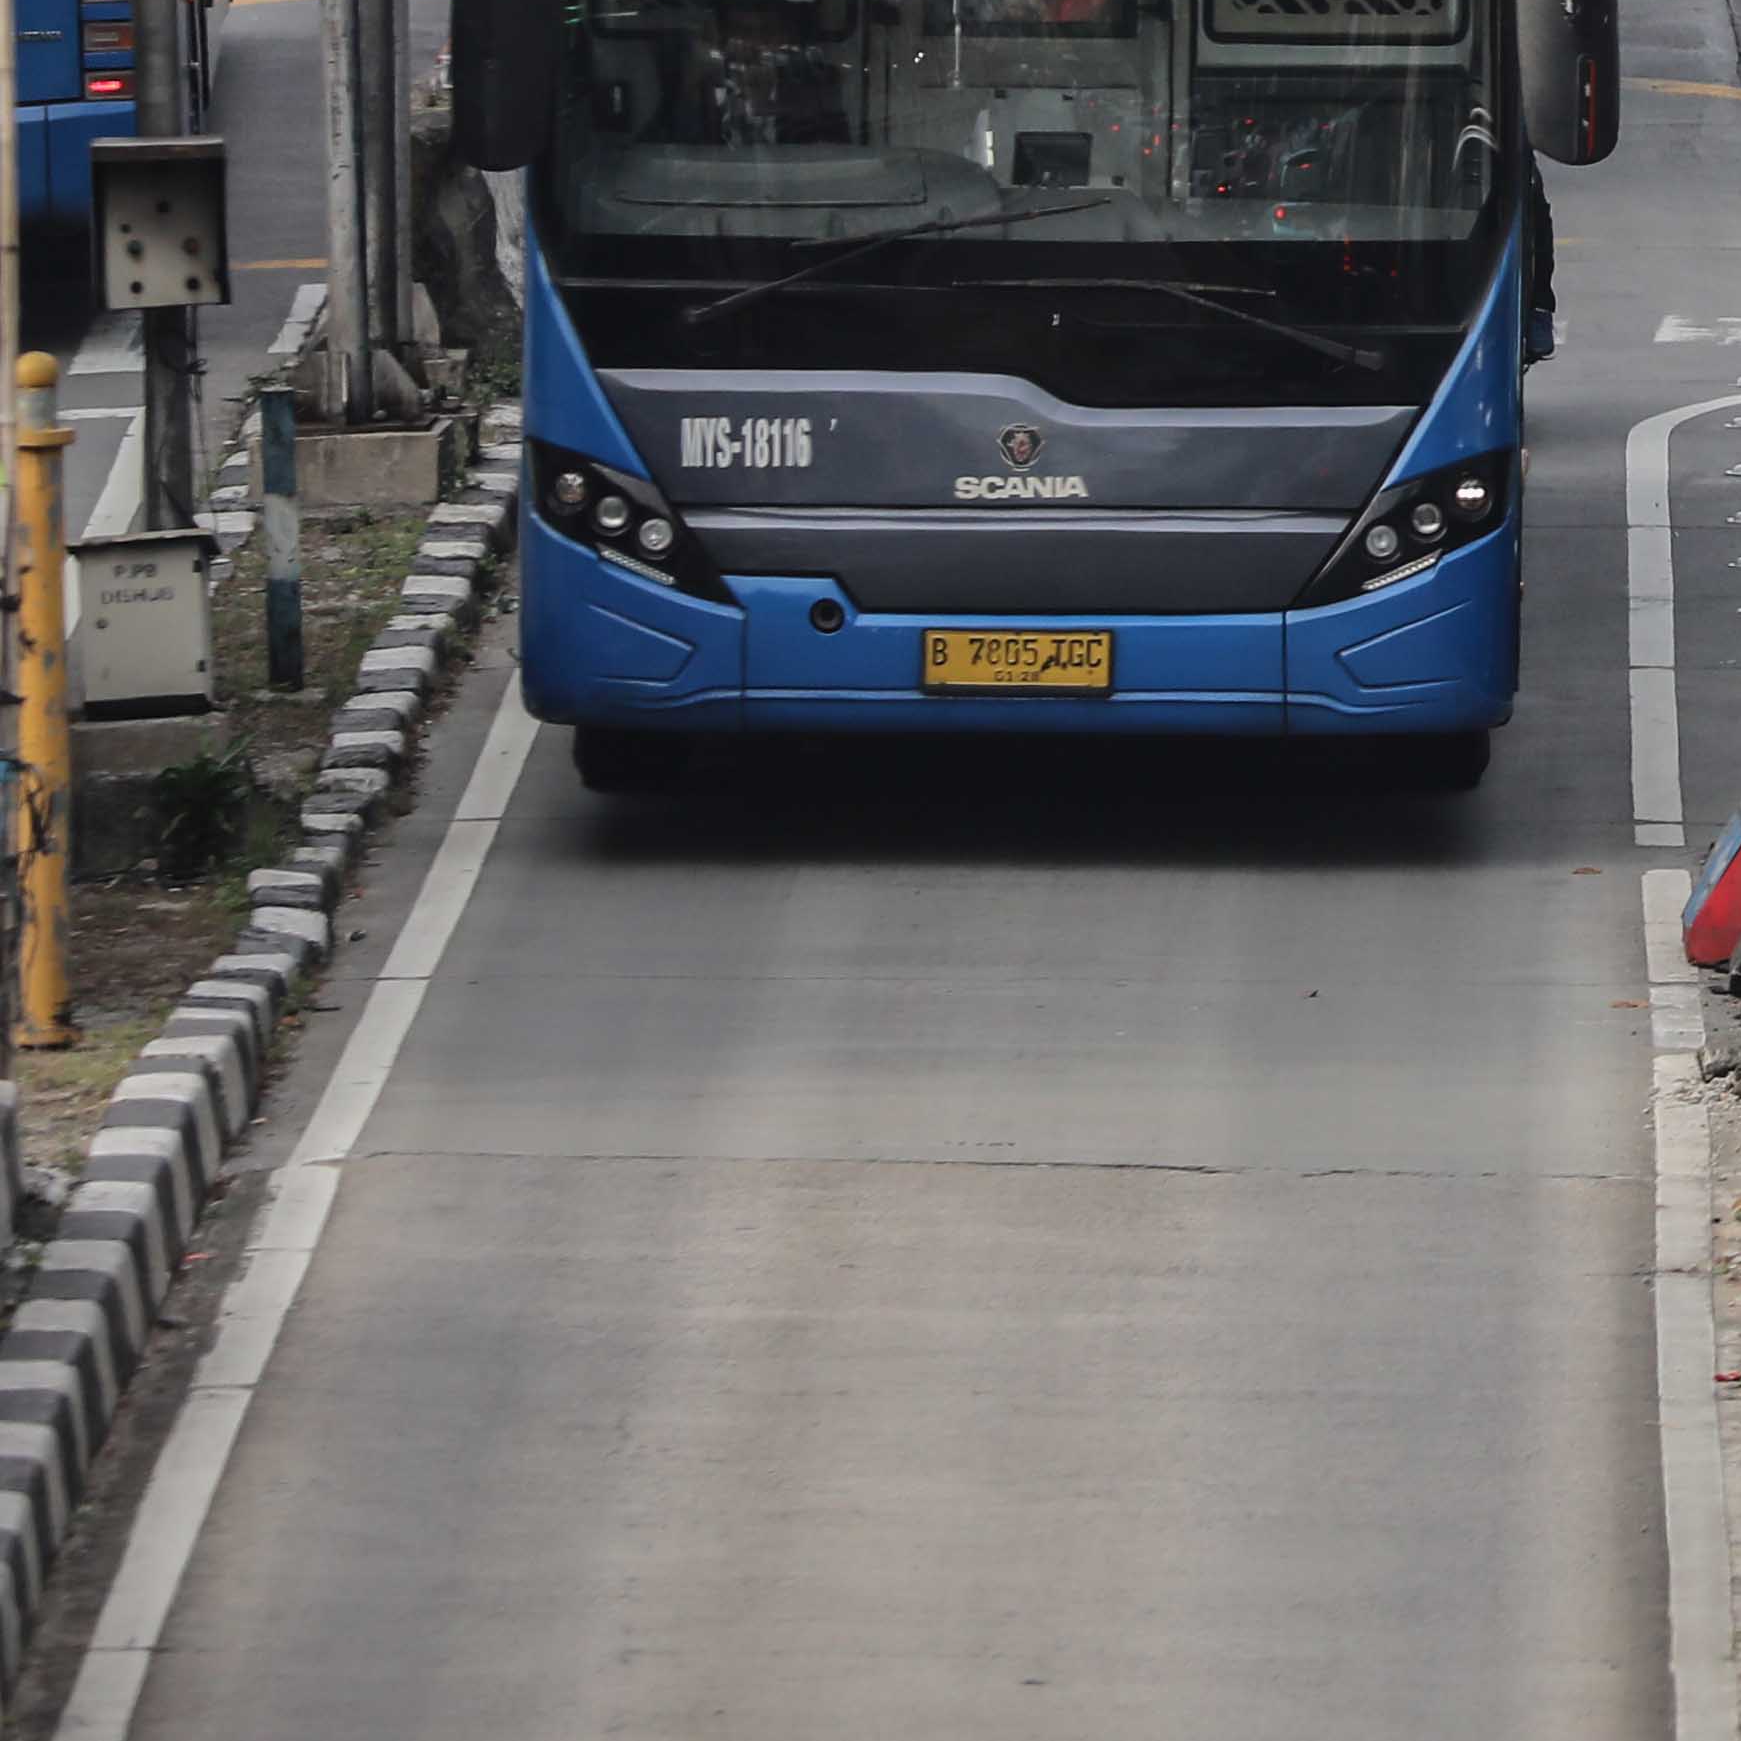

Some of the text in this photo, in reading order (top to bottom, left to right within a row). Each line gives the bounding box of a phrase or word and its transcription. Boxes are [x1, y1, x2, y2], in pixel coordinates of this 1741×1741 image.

[681, 417, 812, 468] MYS-18116
[954, 476, 1089, 499] SCANIA
[931, 638, 948, 665] B
[968, 637, 1037, 666] 7805
